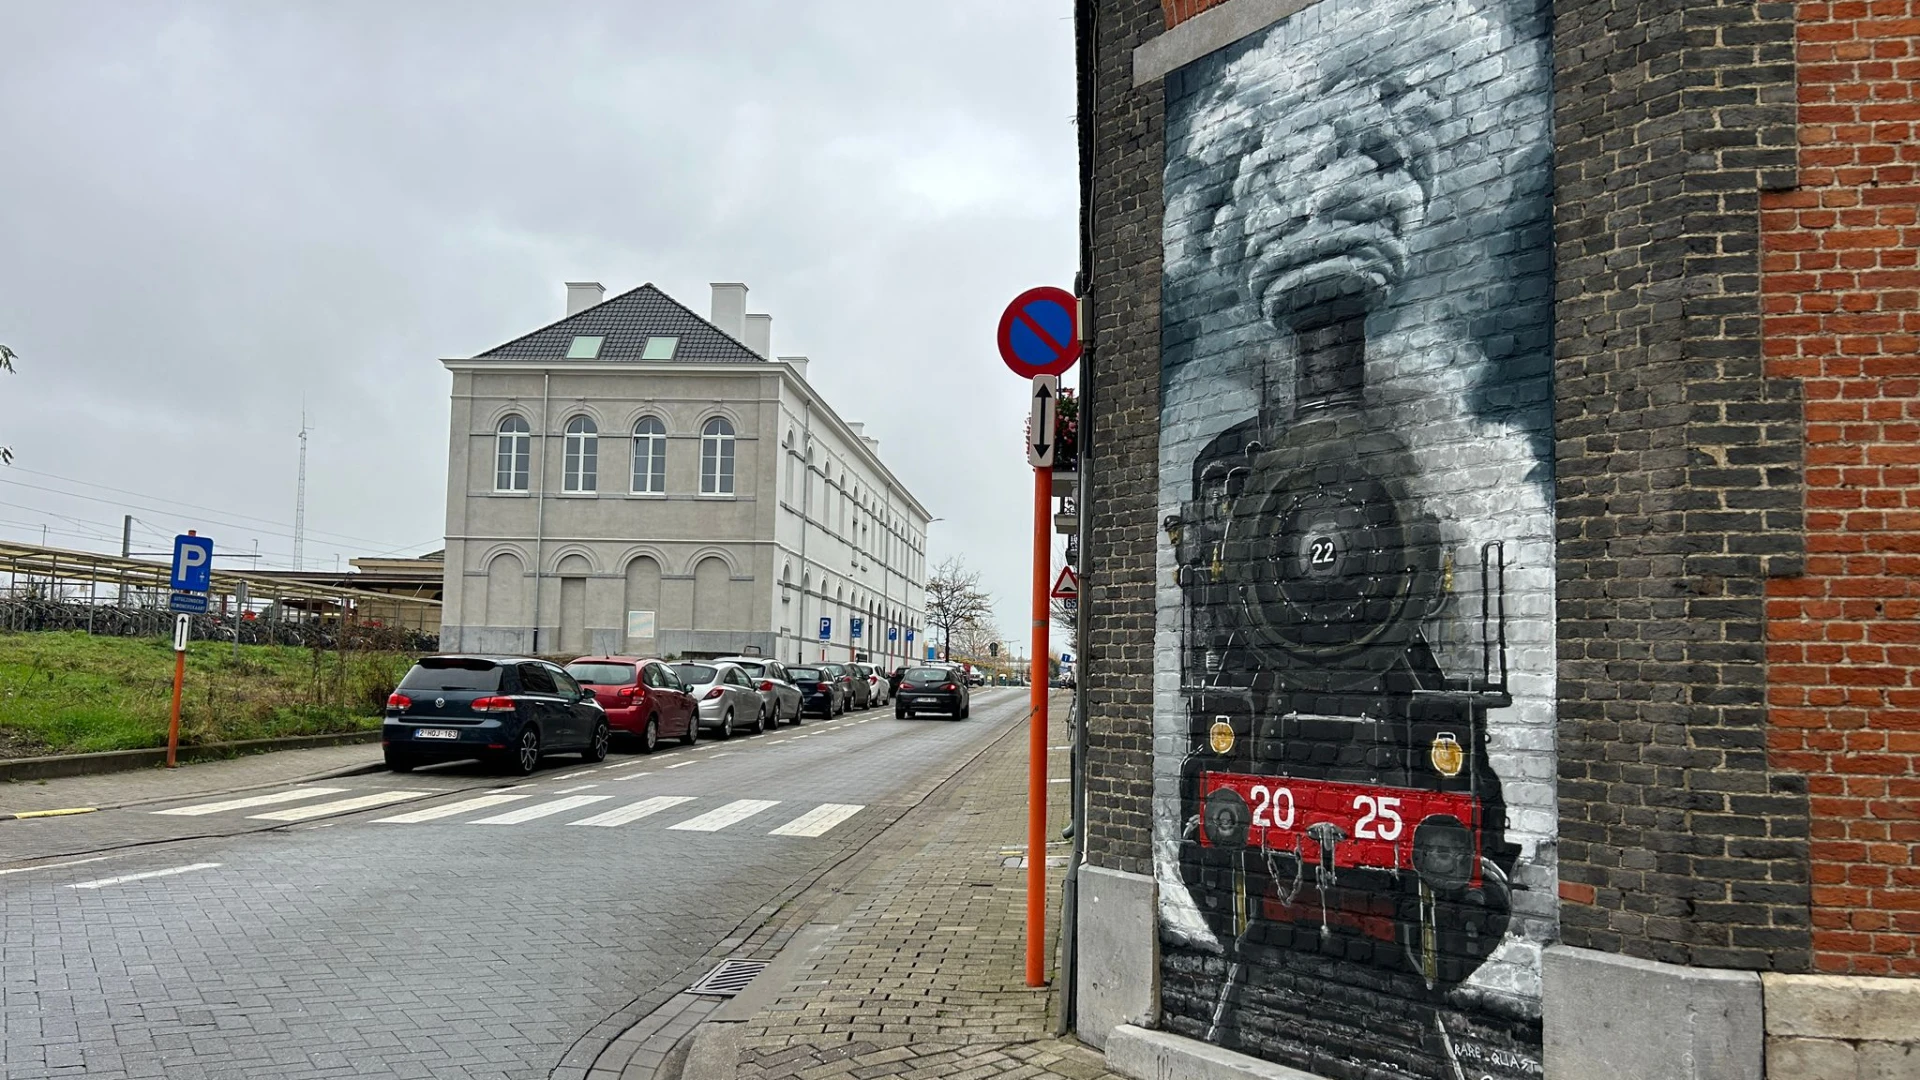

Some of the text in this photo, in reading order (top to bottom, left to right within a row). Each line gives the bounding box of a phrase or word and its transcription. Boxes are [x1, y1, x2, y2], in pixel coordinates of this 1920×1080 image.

[1312, 542, 1334, 564] 22
[178, 544, 207, 581] P
[1065, 599, 1077, 608] 65
[821, 620, 829, 631] P
[853, 619, 860, 627] P
[1250, 785, 1402, 841] 20 25
